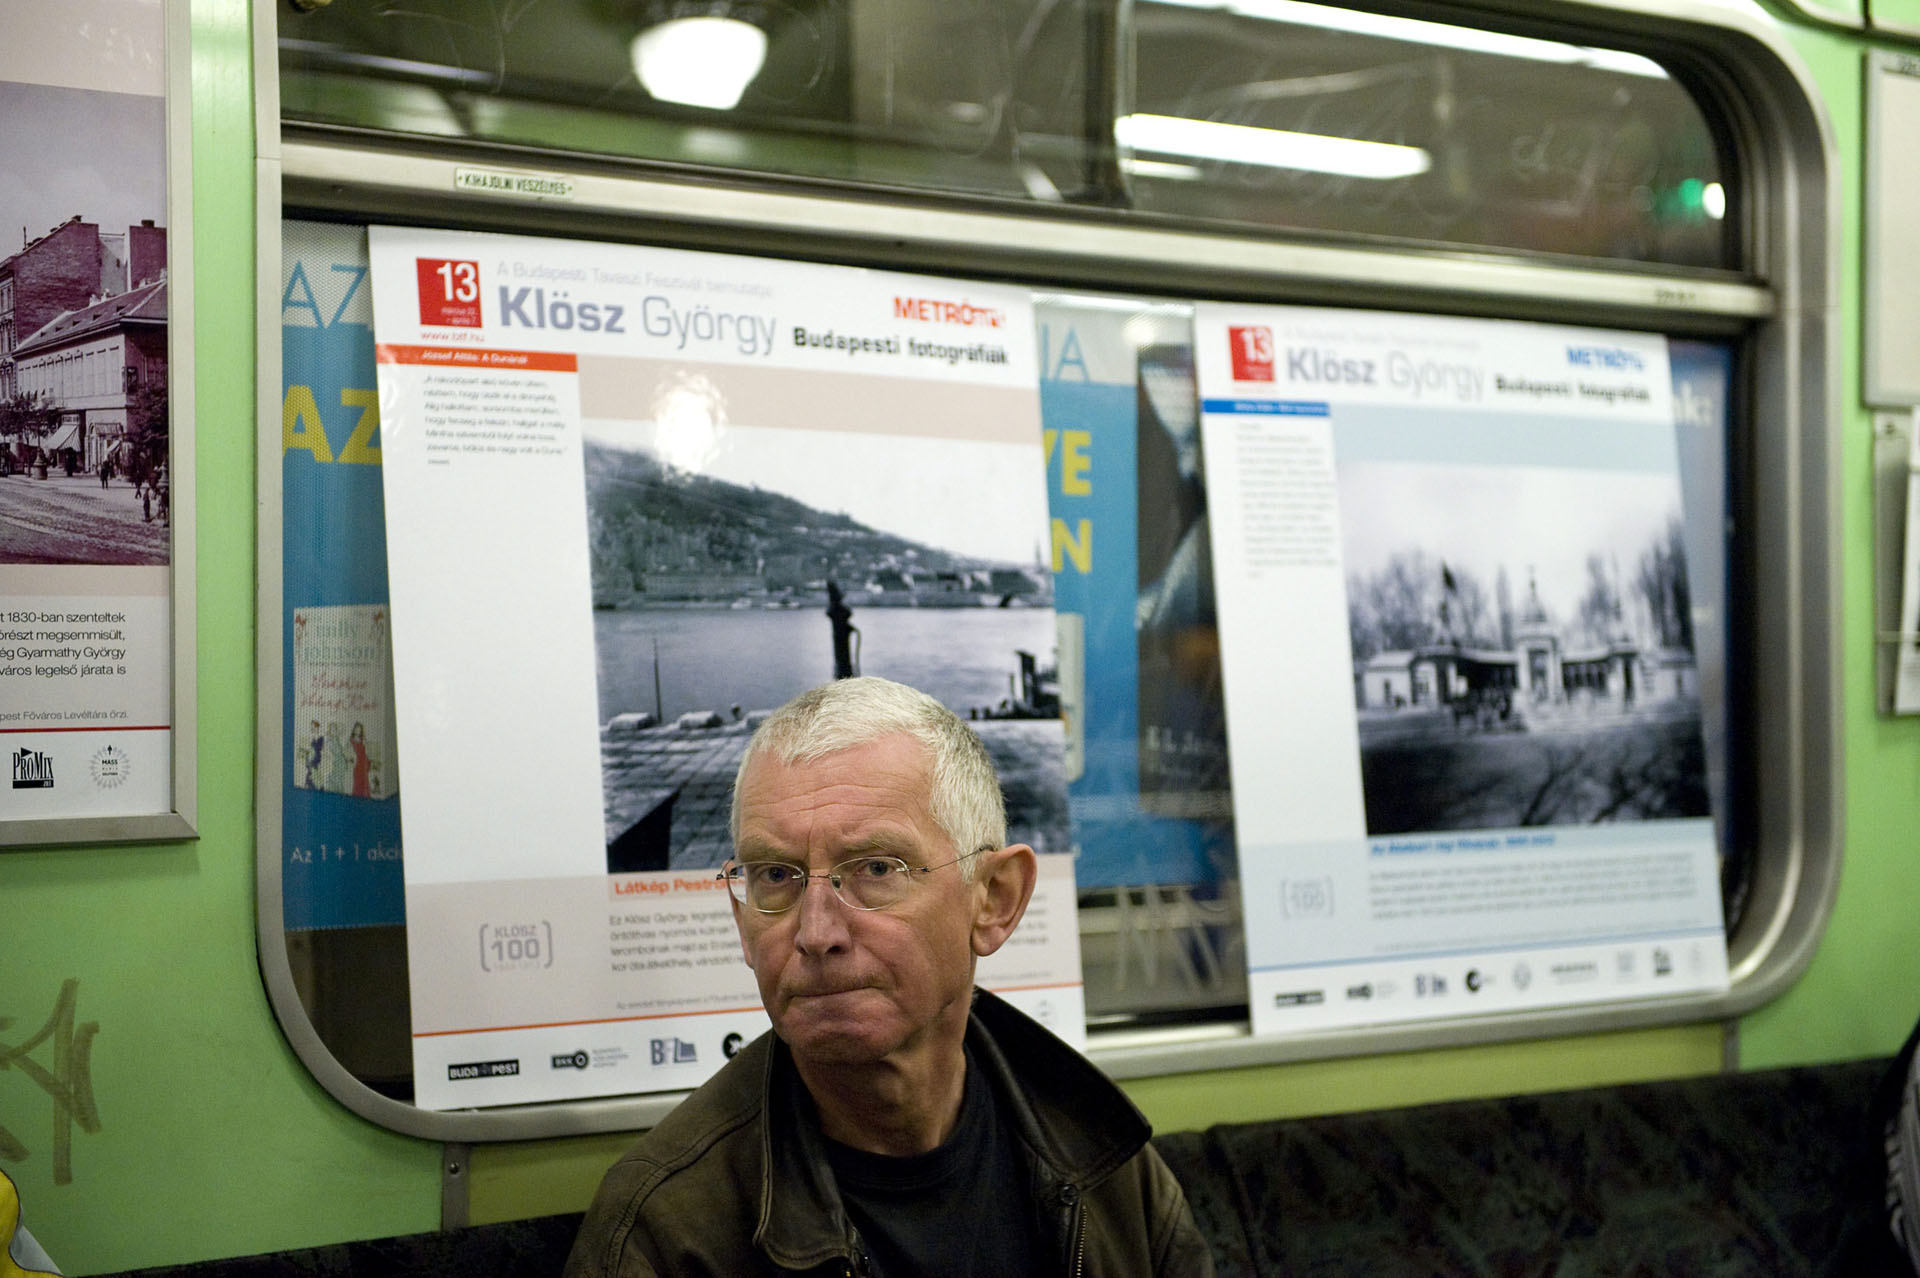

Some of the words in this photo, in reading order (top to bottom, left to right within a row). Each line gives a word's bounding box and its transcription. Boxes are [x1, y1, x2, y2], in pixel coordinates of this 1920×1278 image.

[282, 261, 367, 328] AZ
[437, 262, 478, 302] 13
[498, 284, 626, 334] Klösz
[641, 295, 777, 356] György
[793, 326, 900, 356] Budapesti
[1241, 328, 1272, 362] 13
[1286, 348, 1376, 384] Klösz
[282, 385, 382, 464] AZ
[8, 612, 64, 623] 1830-ban
[66, 612, 126, 623] szenteltek
[36, 629, 125, 643] megsemmisült,
[17, 647, 81, 660] Gyarmathy
[83, 647, 126, 660] György
[0, 665, 32, 676] város
[35, 664, 77, 678] legelső
[80, 665, 114, 678] járata
[117, 664, 126, 675] is
[64, 710, 107, 720] Levéltára
[615, 880, 670, 896] Látkép
[491, 938, 540, 961] 100
